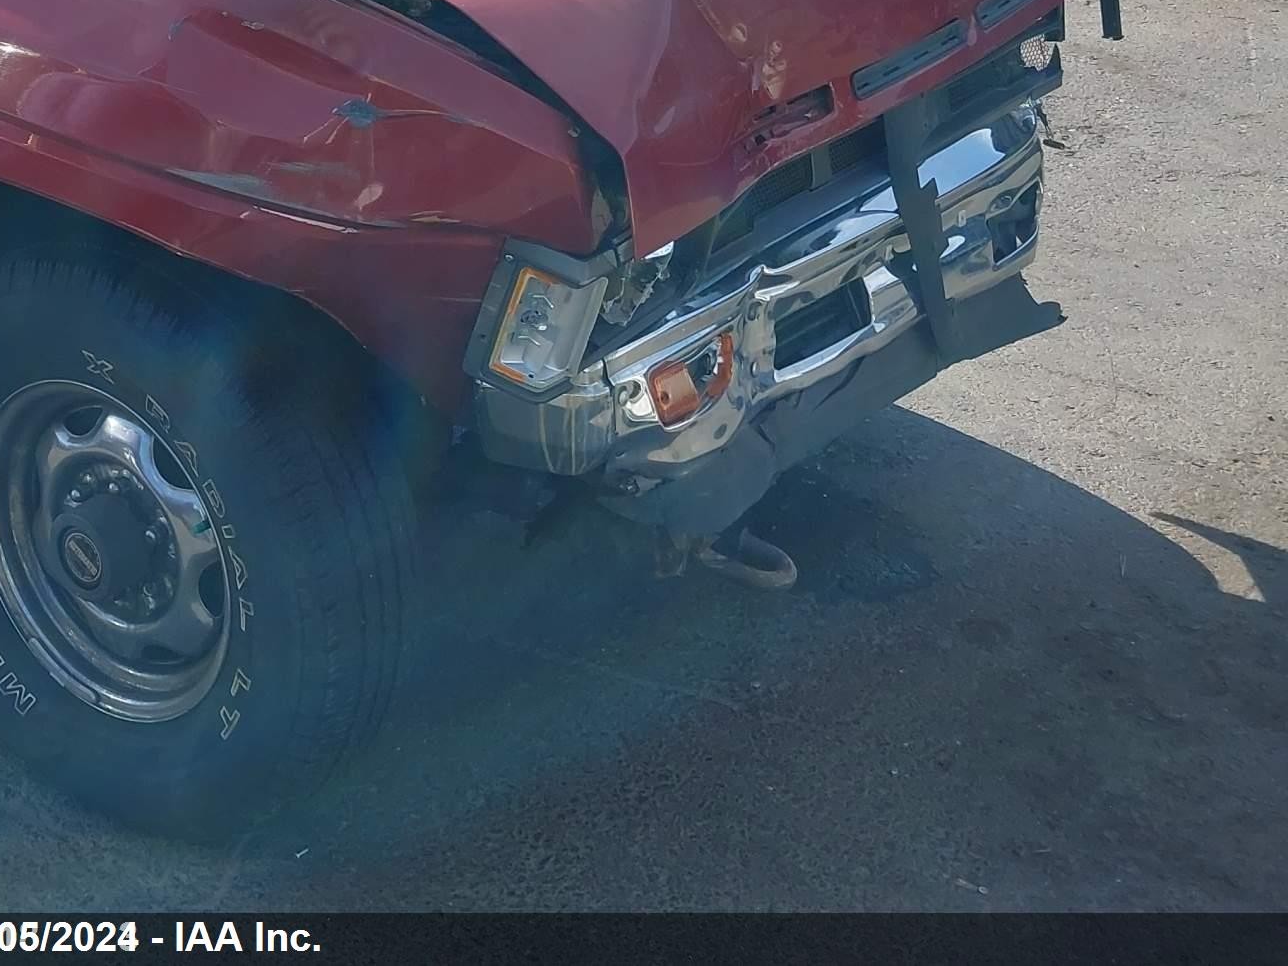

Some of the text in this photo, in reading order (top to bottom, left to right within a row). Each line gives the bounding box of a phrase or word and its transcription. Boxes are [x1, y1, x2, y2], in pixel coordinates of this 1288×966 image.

[81, 349, 255, 740] X RADIAL LT
